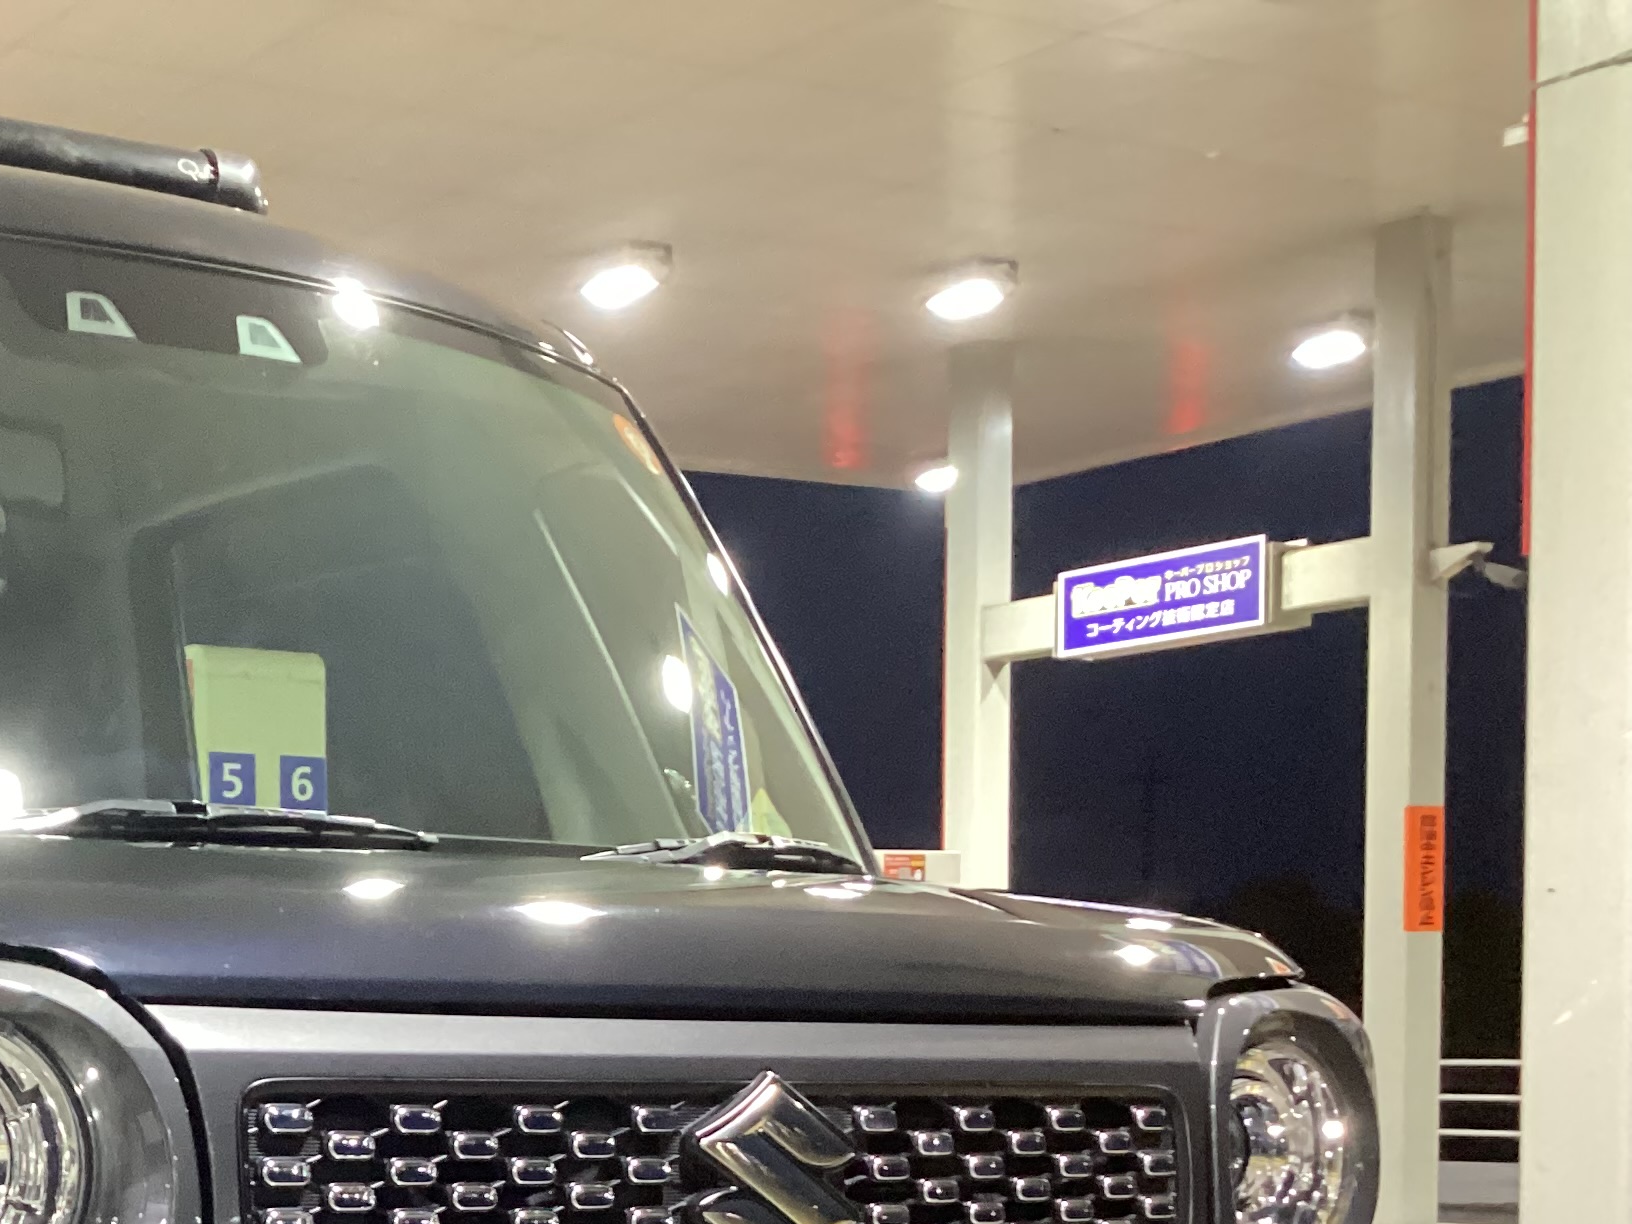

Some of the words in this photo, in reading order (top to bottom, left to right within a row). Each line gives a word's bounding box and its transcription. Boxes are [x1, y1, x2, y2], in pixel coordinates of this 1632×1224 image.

[1164, 579, 1201, 602] PRO
[1202, 569, 1252, 597] SHOP
[221, 762, 244, 799] 5
[291, 765, 314, 802] 6
